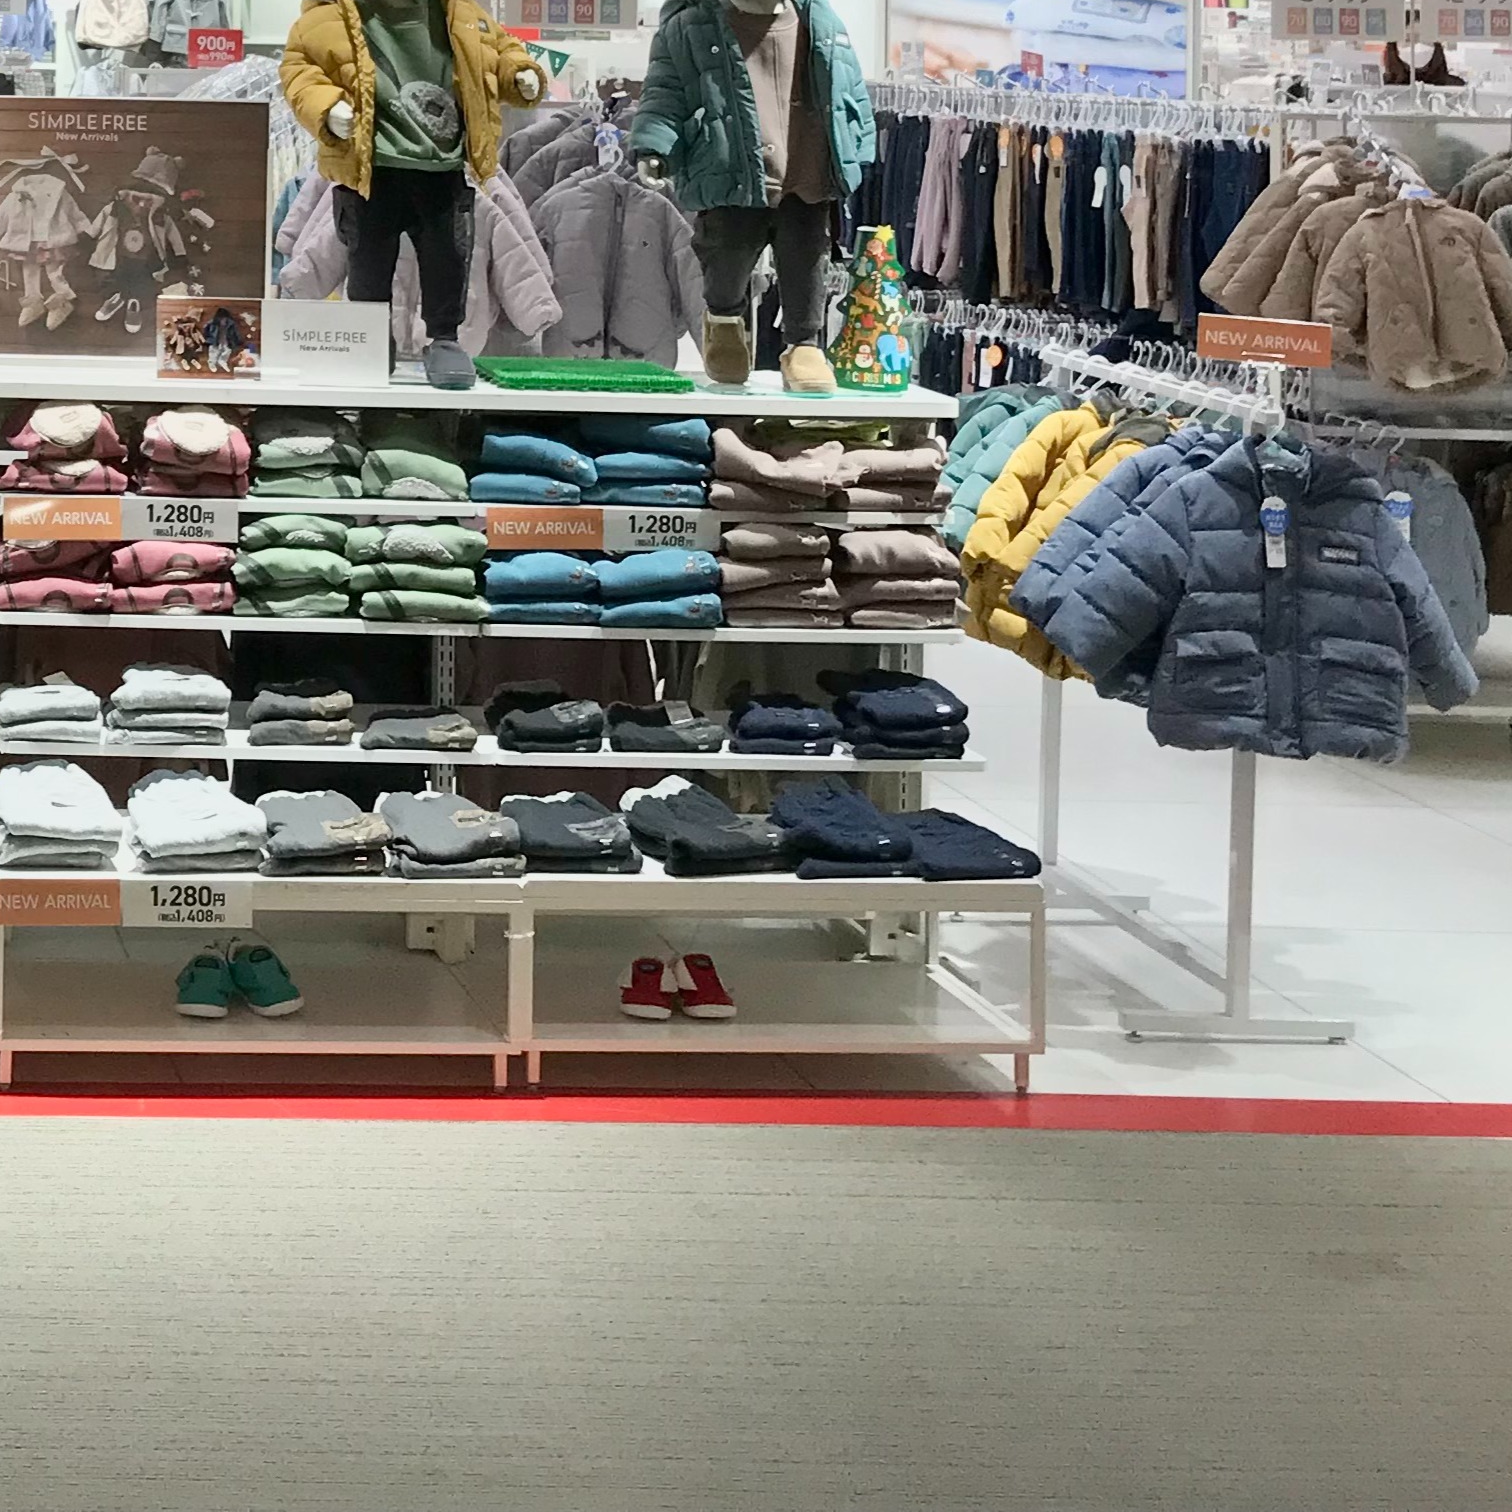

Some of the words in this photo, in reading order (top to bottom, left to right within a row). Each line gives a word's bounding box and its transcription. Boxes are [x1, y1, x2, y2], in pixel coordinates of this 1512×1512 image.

[576, 3, 592, 15] 90
[196, 35, 236, 51] 900円
[101, 114, 148, 131] FREE
[55, 131, 78, 141] New
[79, 132, 119, 142] Arrivals
[335, 331, 367, 344] FREE
[1205, 329, 1247, 346] NEW
[1251, 334, 1322, 353] ARRIVAL
[299, 344, 317, 352] New
[318, 345, 350, 353] Arrivals
[9, 511, 47, 525] NEW
[51, 511, 113, 526] ARRIVAL
[146, 503, 215, 524] 1,280円
[493, 521, 531, 535] NEW
[534, 521, 596, 536] ARRIVAL
[628, 514, 697, 535] 1,280円
[44, 894, 111, 910] ARRIVAL
[150, 885, 226, 908] 1,280円
